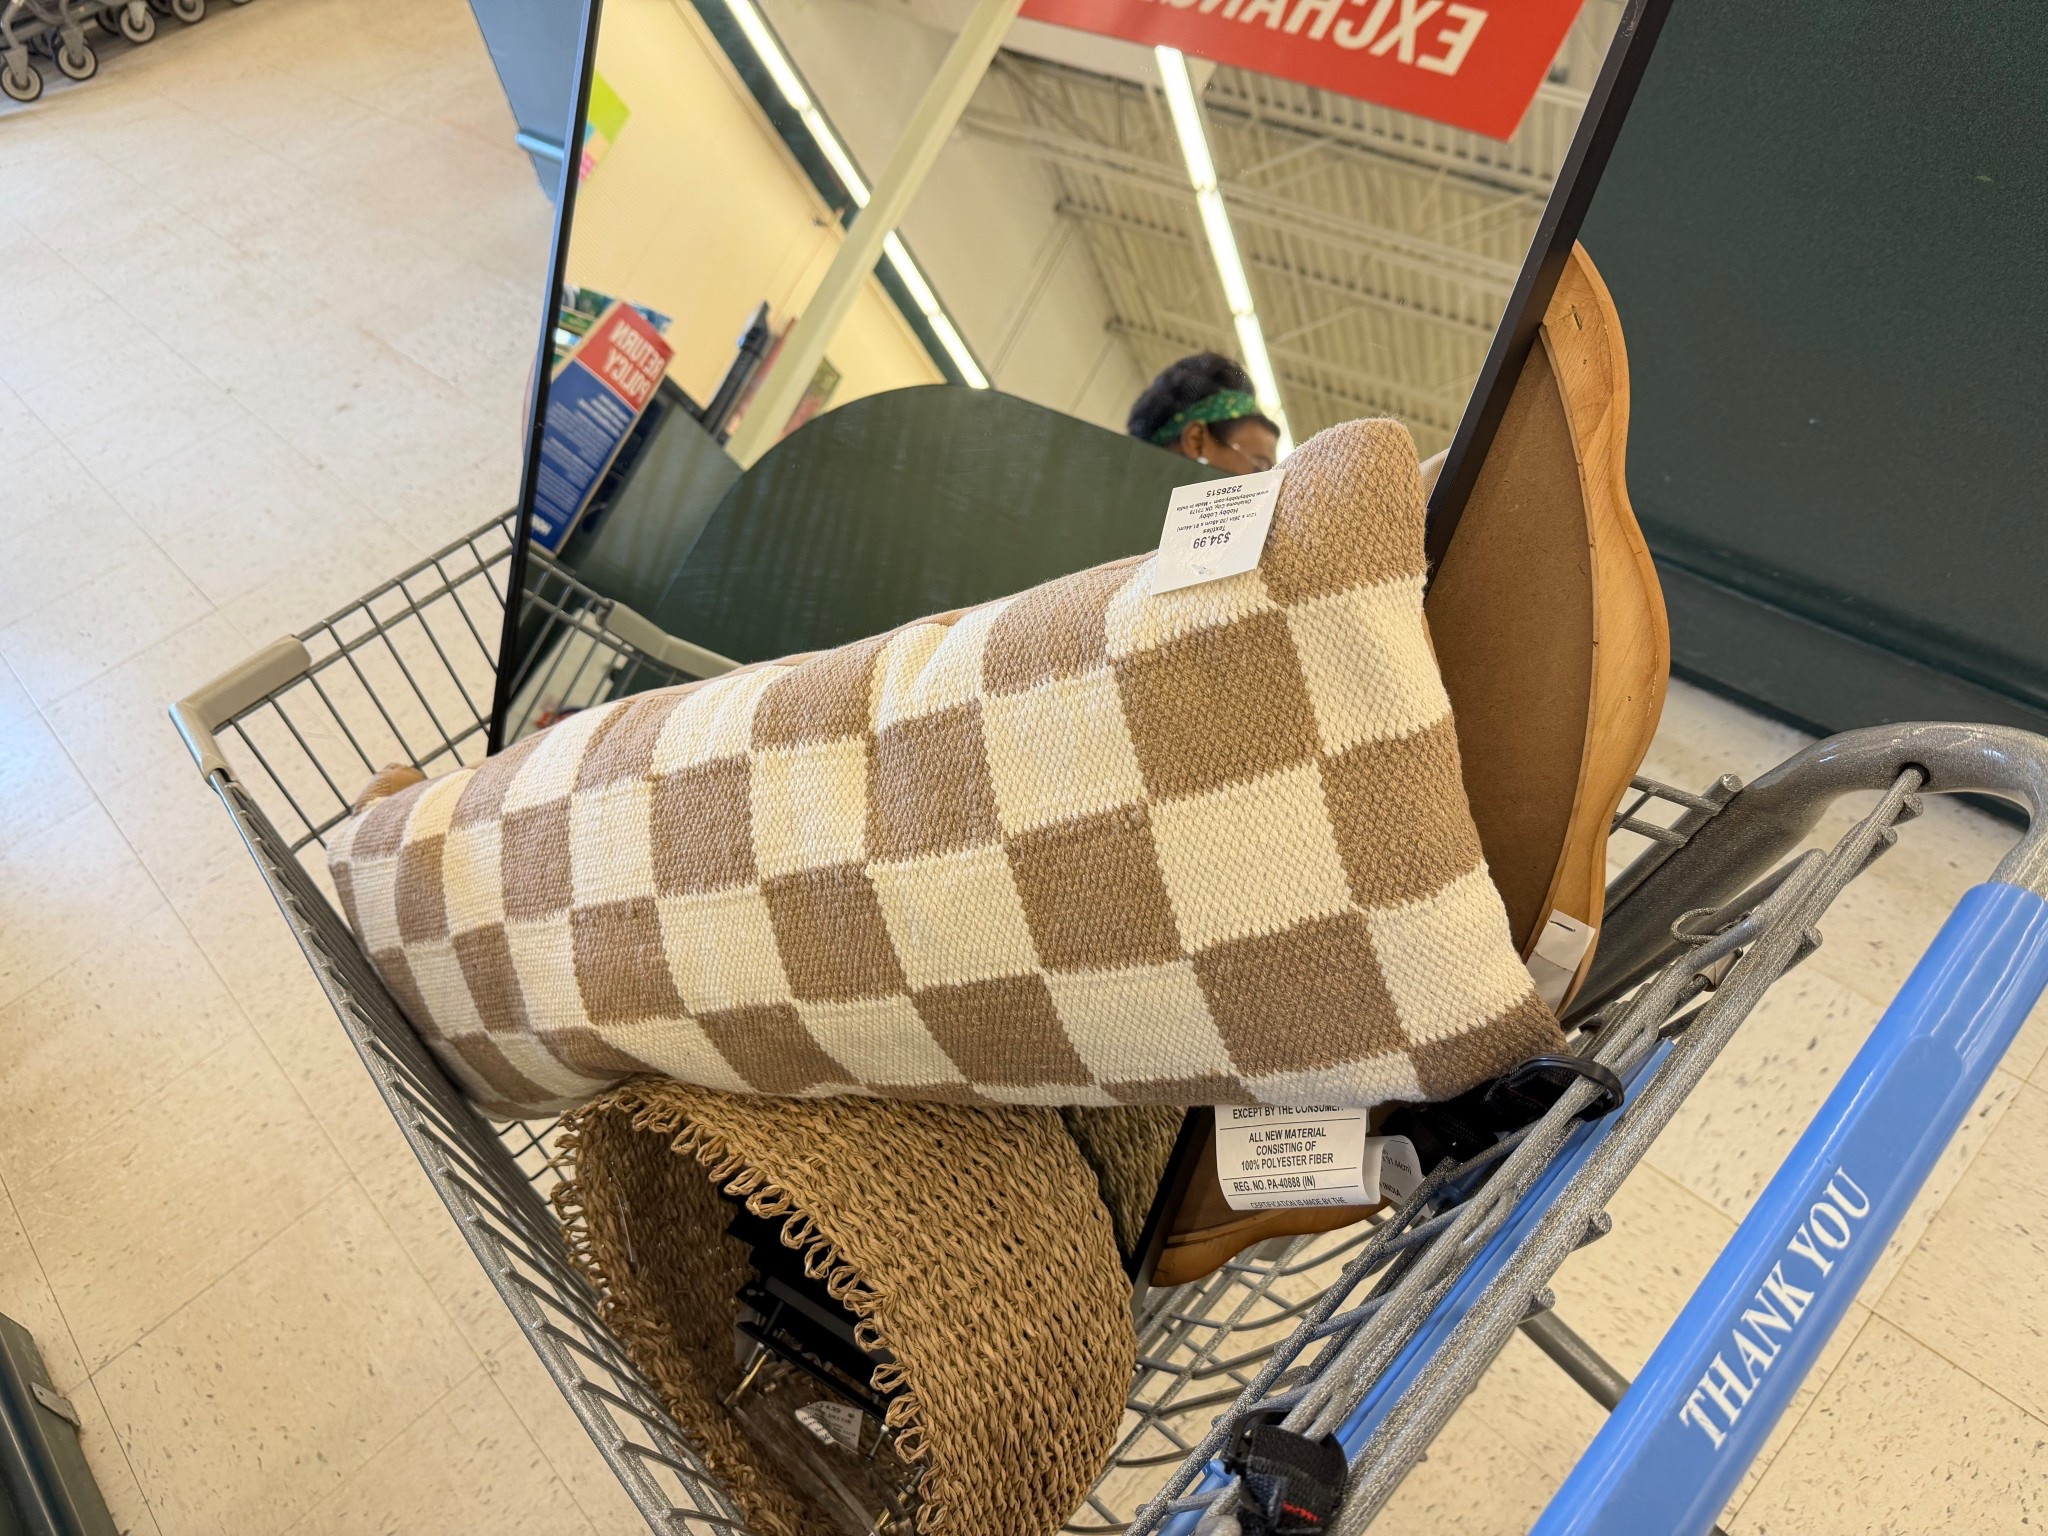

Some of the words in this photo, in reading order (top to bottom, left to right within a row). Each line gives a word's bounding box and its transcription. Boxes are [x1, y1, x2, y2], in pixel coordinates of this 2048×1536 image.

[1206, 485, 1243, 497] 2526515
[1198, 512, 1218, 520] Lobby
[1219, 508, 1239, 516] Hobby
[1202, 525, 1226, 534] Textiles
[1193, 531, 1231, 549] $34.99
[1232, 1107, 1262, 1119] EXCEPT
[1264, 1106, 1275, 1116] BY
[1277, 1105, 1294, 1115] THE
[1248, 1132, 1264, 1144] ALL
[1265, 1129, 1283, 1141] NEW
[1284, 1127, 1327, 1139] MATERIAL
[1256, 1142, 1303, 1156] CONSISTING
[1304, 1141, 1317, 1151] OF
[1241, 1161, 1261, 1171] 100%
[1261, 1155, 1307, 1169] POLYESTER
[1308, 1152, 1334, 1165] FIBER
[1233, 1180, 1253, 1193] REG.
[1252, 1179, 1267, 1192] NO.
[1268, 1176, 1301, 1190] PA-40888
[1302, 1175, 1316, 1190] (IN)
[1250, 1201, 1297, 1209] CERTIFICATION
[1679, 1260, 1815, 1451] THANK
[1787, 1165, 1870, 1278] YOU
